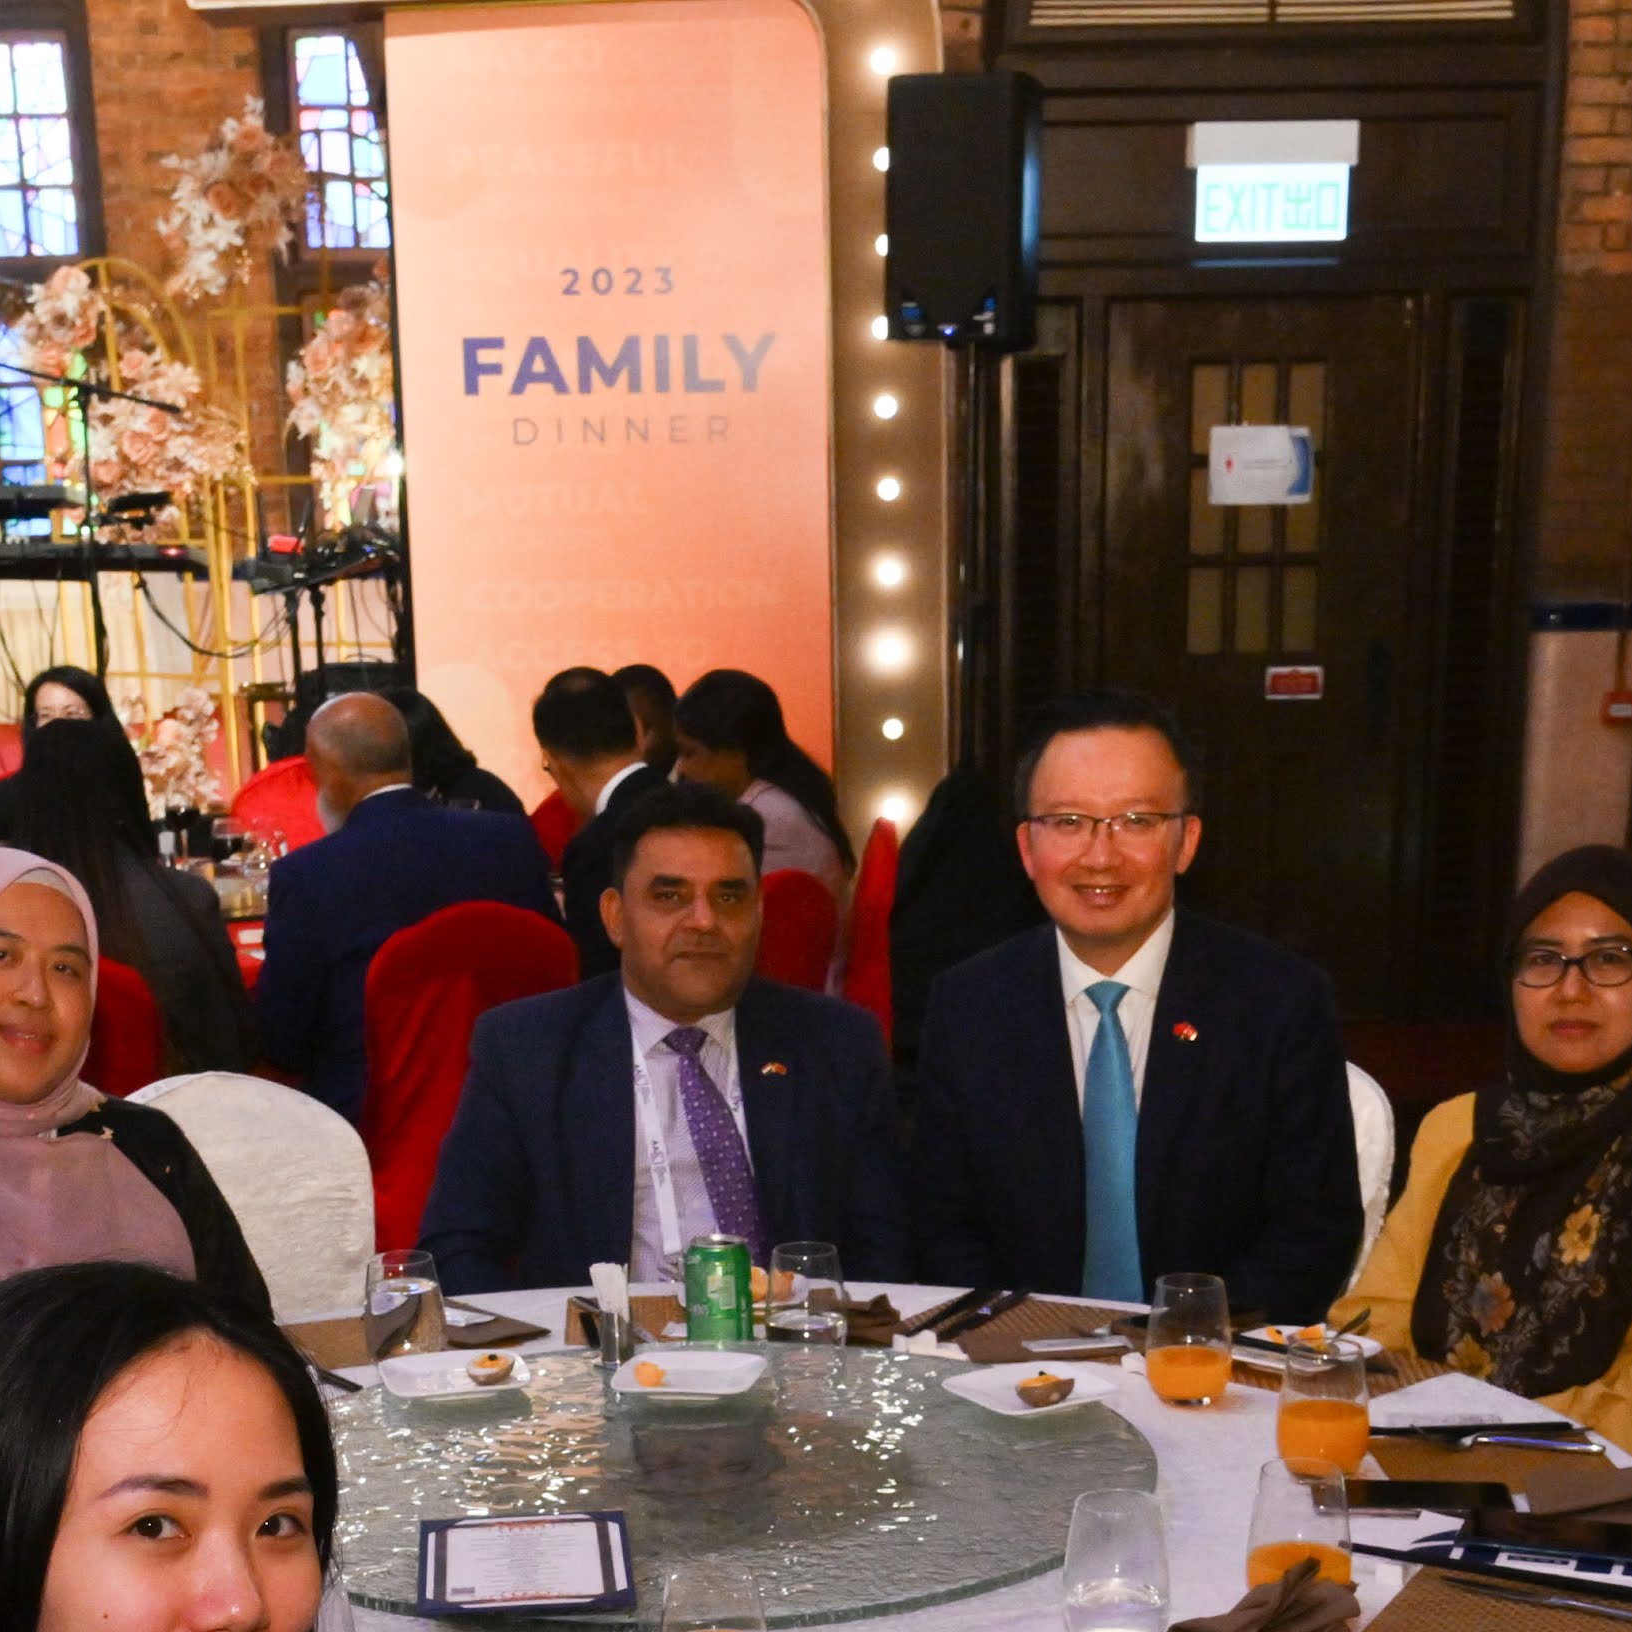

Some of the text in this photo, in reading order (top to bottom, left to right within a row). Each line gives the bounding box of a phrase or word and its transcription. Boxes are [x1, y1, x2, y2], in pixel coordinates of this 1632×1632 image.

[1204, 183, 1278, 233] EXIT
[1284, 181, 1341, 232] 出口
[560, 267, 675, 296] 2023
[463, 333, 777, 397] FAMILY
[513, 415, 730, 446] DINNER
